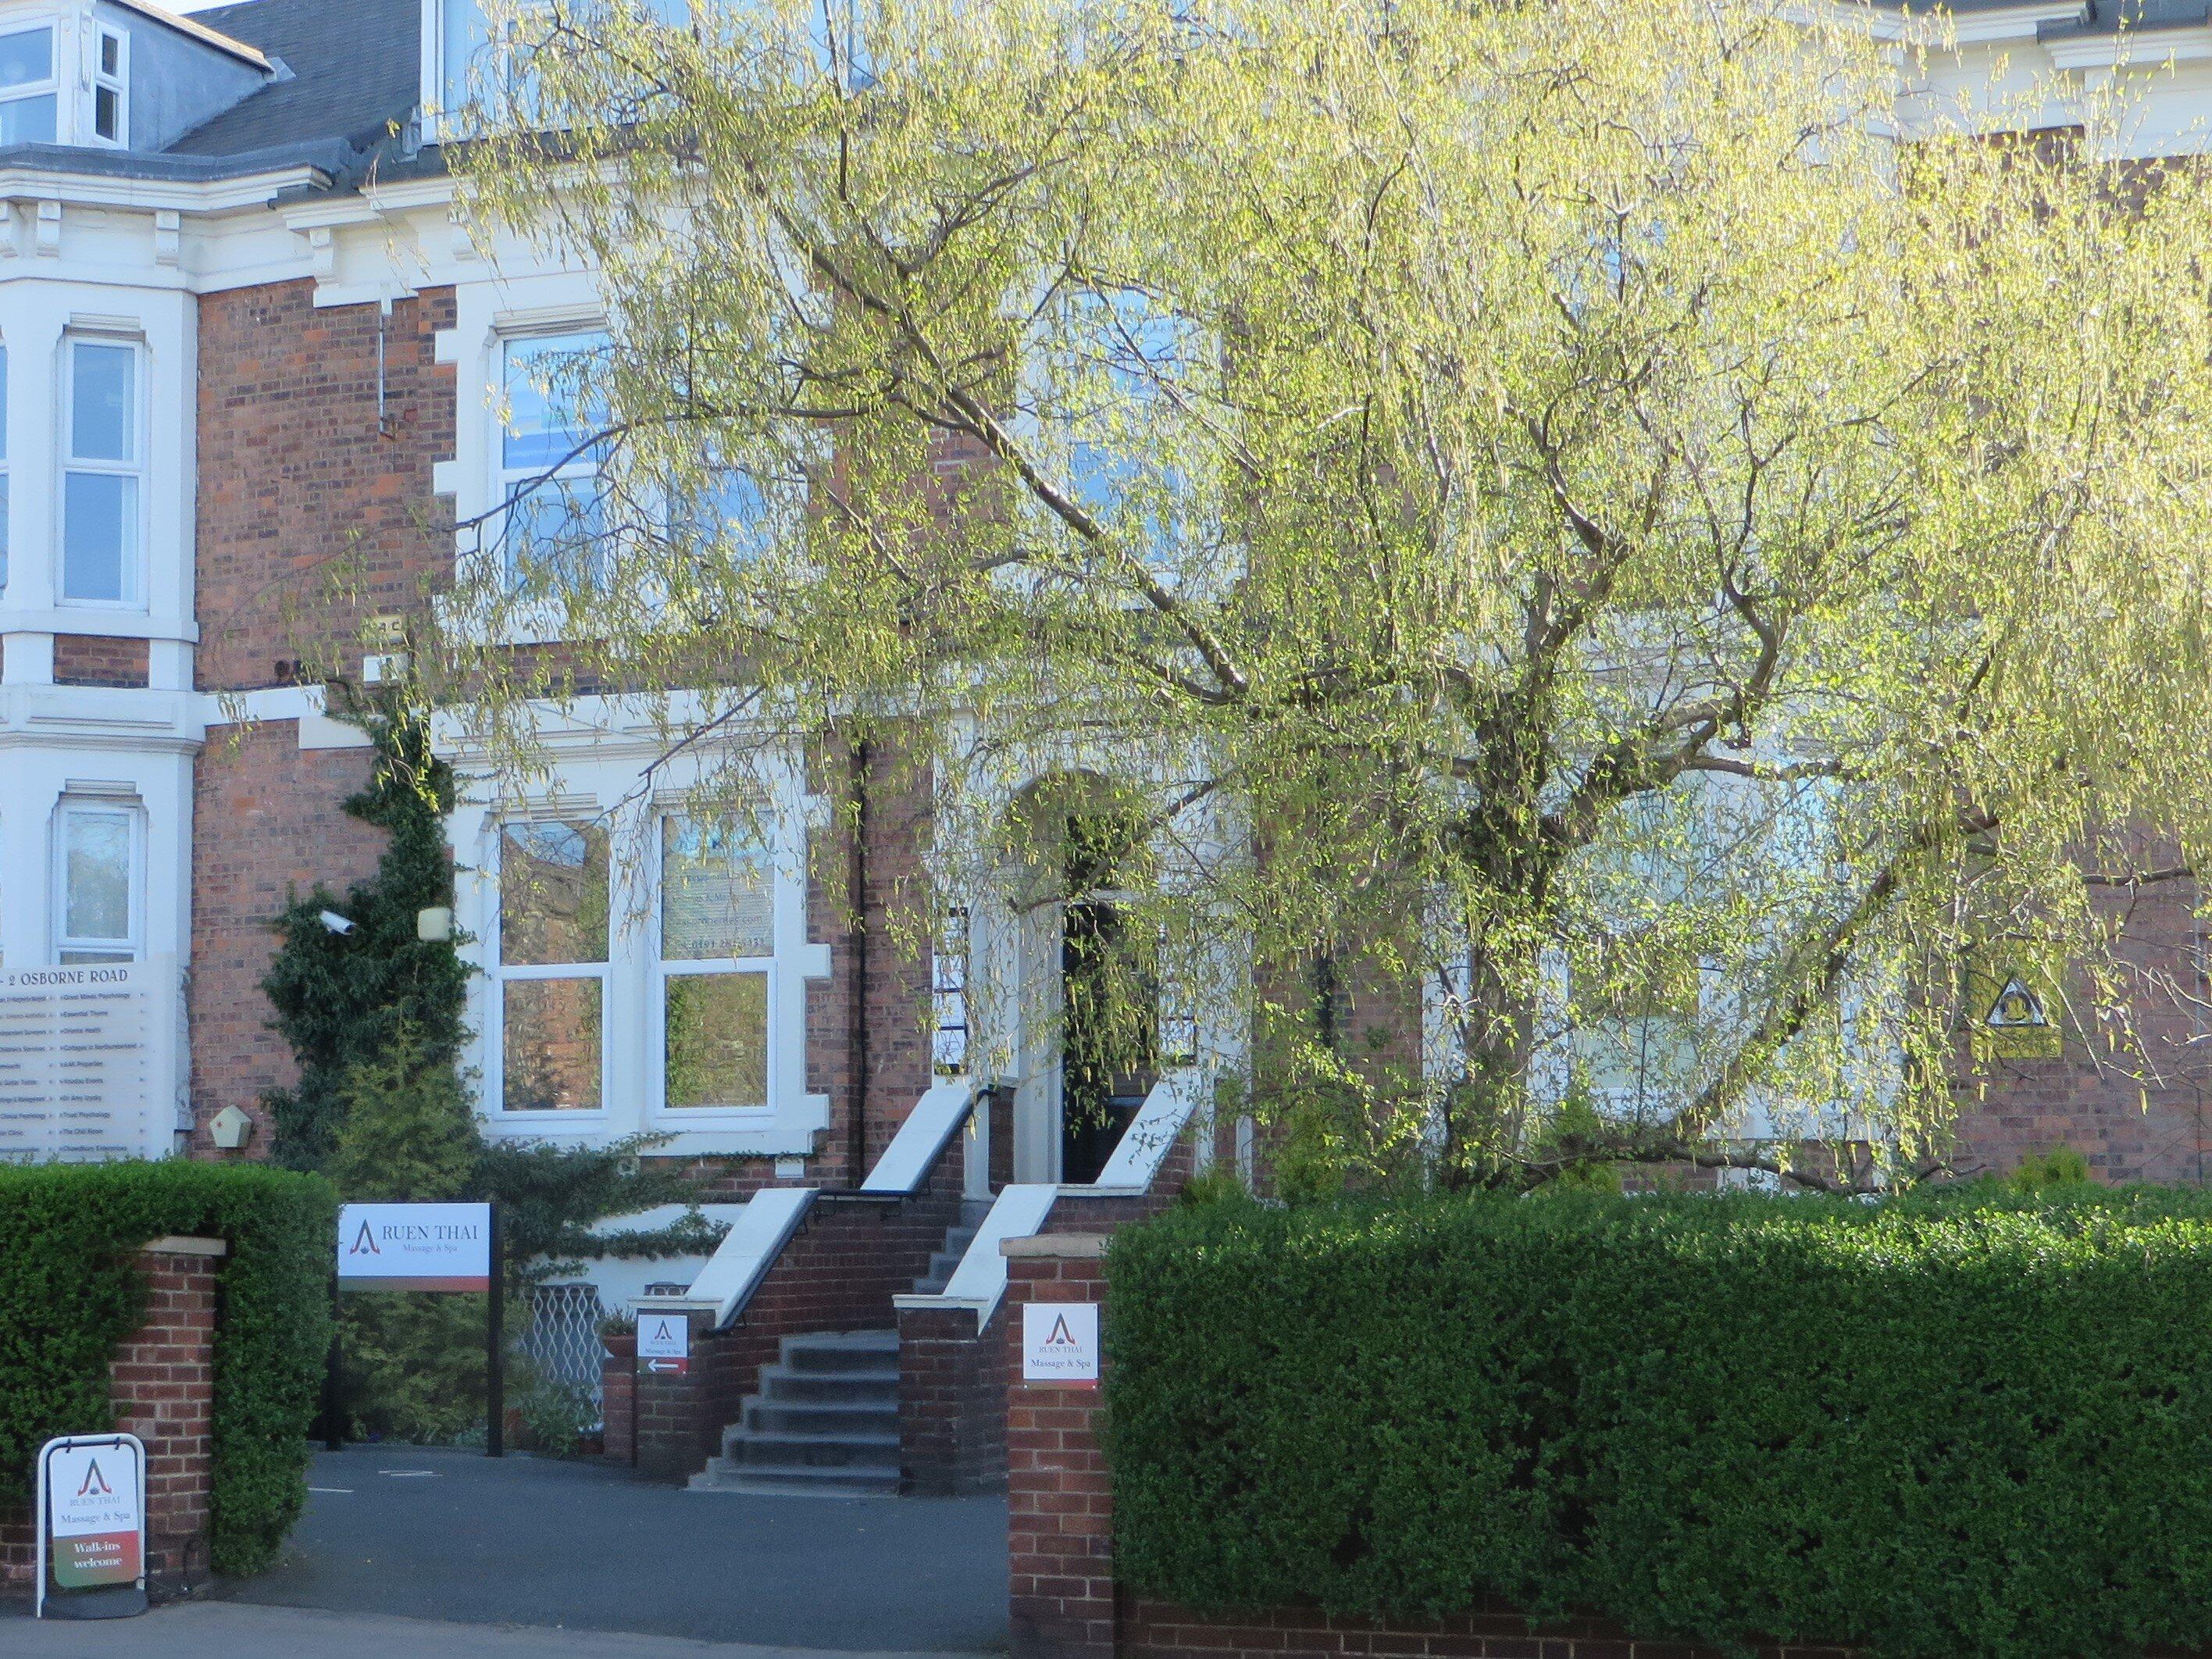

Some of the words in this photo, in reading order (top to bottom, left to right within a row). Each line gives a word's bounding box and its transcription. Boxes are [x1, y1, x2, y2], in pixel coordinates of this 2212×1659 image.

[9, 975, 16, 986] 2
[21, 972, 84, 985] OSBORNE
[91, 969, 127, 983] ROAD
[382, 1225, 428, 1240] RUEN
[434, 1224, 478, 1240] THAI
[403, 1243, 433, 1254] Massage
[444, 1243, 458, 1254] Spa
[1031, 1359, 1065, 1368] Massage
[1076, 1359, 1090, 1369] Spa
[61, 1514, 101, 1524] Massage
[103, 1512, 111, 1521] &
[114, 1511, 130, 1523] Spa
[74, 1541, 121, 1554] Walk-ins
[73, 1557, 123, 1569] welcome
